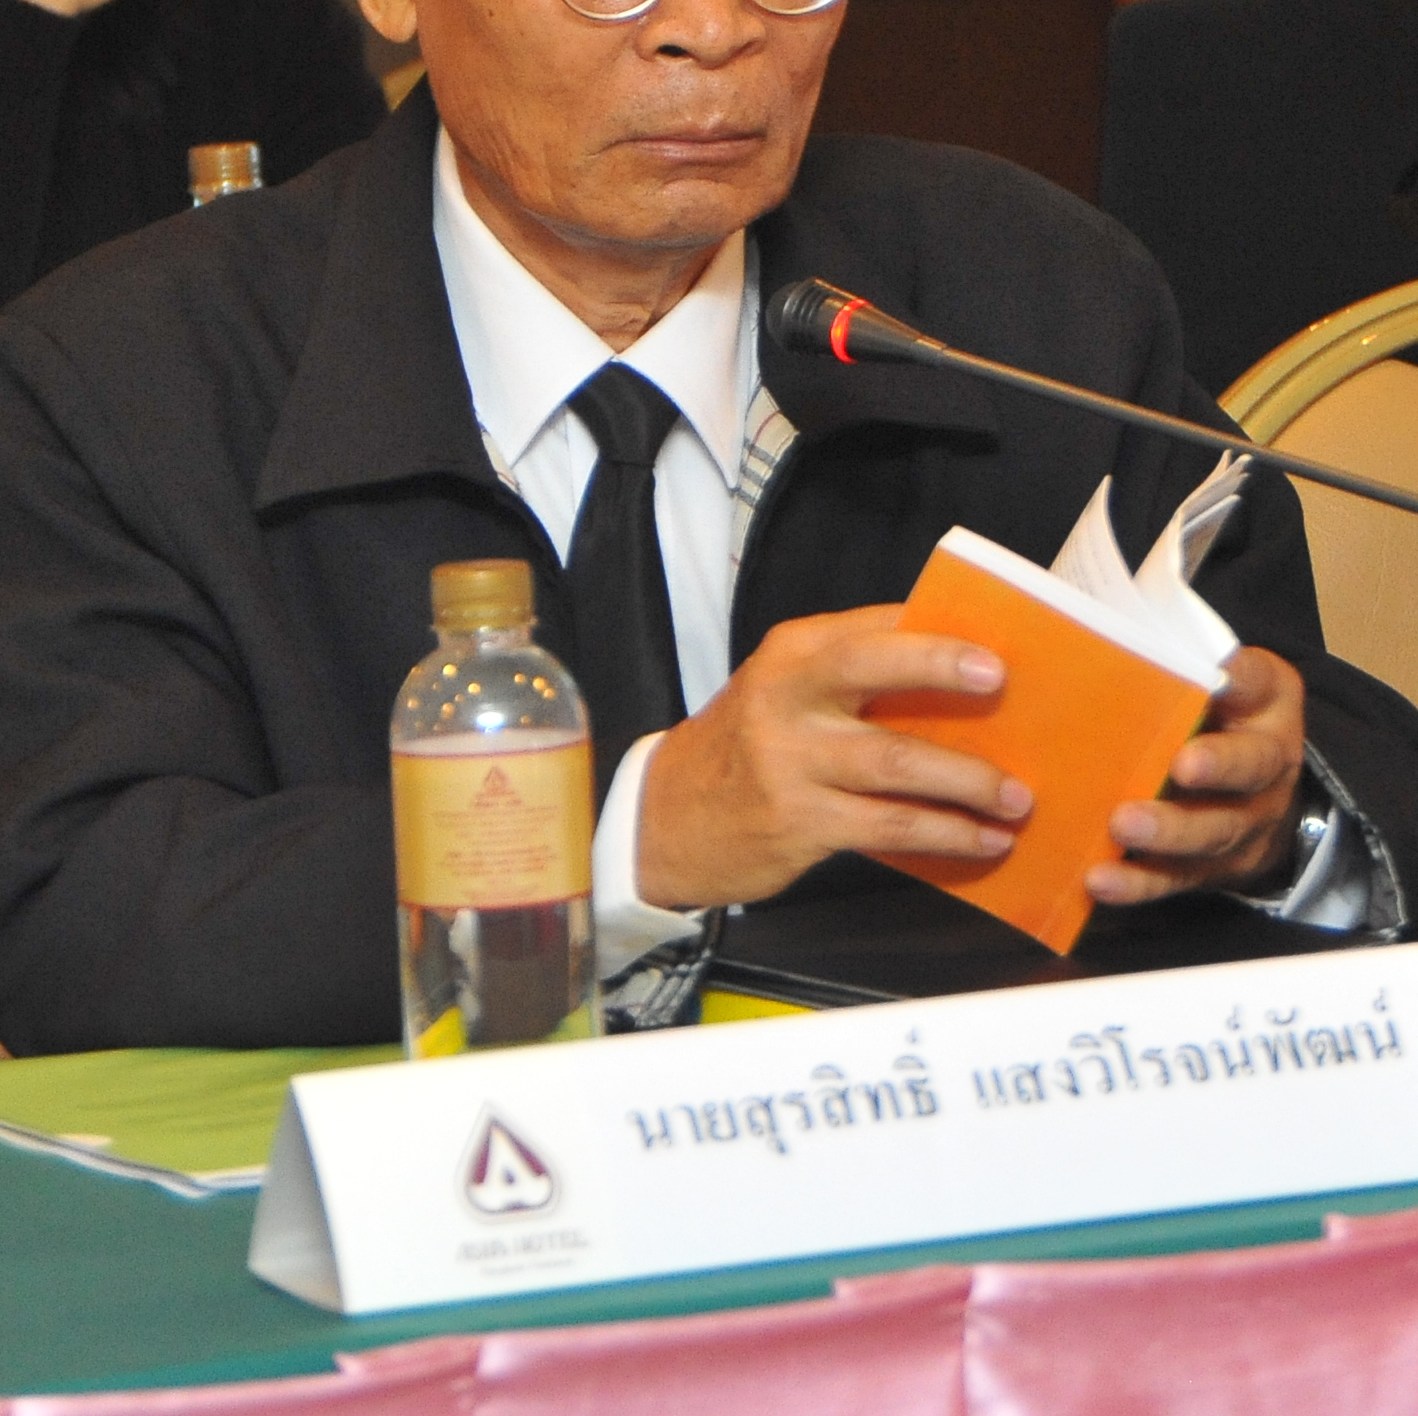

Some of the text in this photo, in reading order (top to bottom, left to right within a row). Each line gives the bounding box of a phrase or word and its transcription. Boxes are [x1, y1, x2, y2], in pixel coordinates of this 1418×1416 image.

[627, 1028, 938, 1155] นายสุรสิทธิ์
